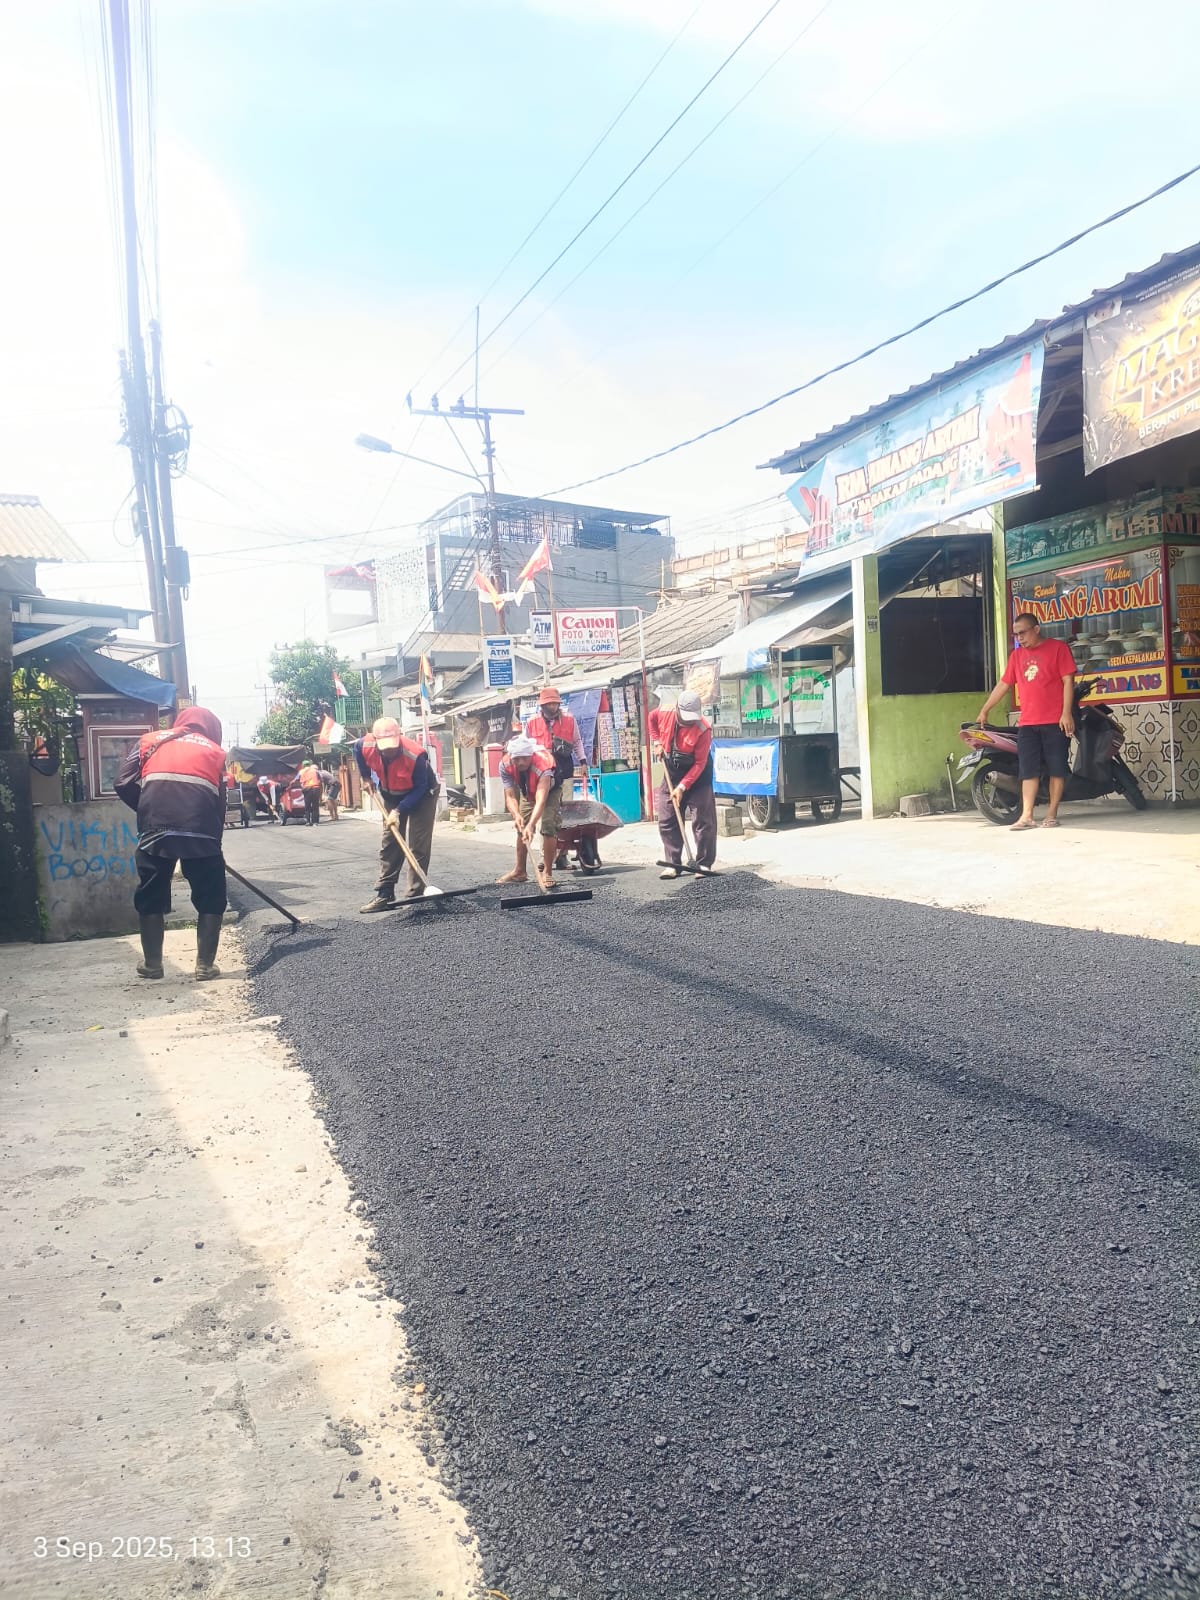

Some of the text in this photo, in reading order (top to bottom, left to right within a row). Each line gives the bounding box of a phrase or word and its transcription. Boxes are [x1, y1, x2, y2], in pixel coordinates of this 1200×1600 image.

[1117, 323, 1199, 394] MAG
[1151, 359, 1200, 403] KRE
[1139, 409, 1180, 439] BERANI
[1104, 567, 1131, 582] Makan
[1013, 568, 1161, 624] MINANG ARUMI
[534, 622, 552, 634] ATM
[561, 616, 615, 629] Canon
[562, 630, 614, 639] FOTO COPY
[1096, 673, 1162, 694] PADANG
[40, 819, 138, 851] VIKIN
